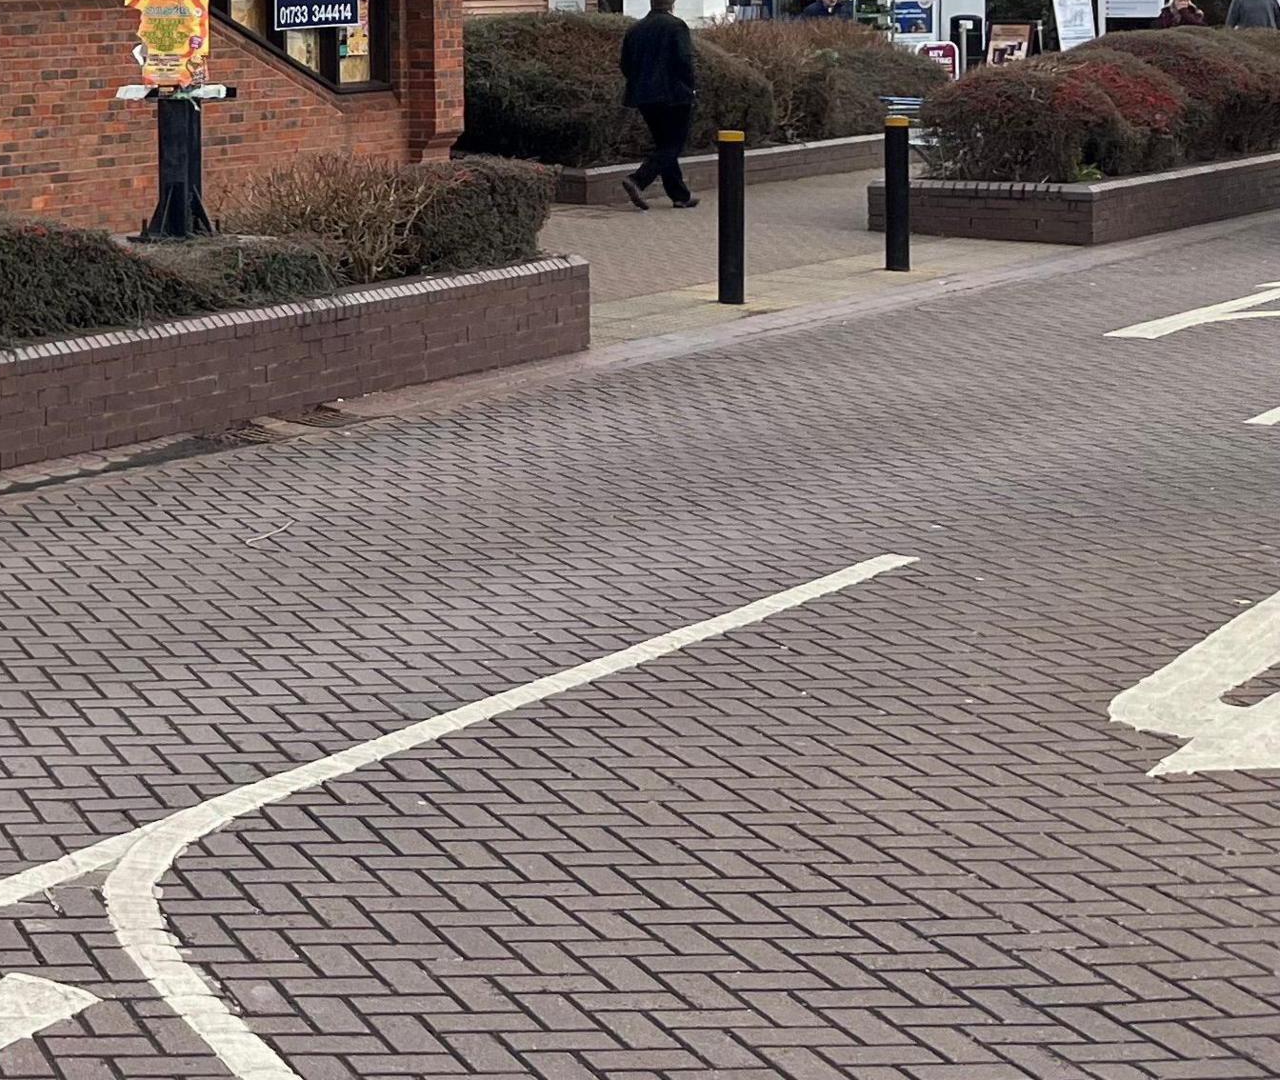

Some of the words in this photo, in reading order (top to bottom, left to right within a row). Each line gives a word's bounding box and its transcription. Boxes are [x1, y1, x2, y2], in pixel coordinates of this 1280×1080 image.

[279, 4, 308, 25] 01733
[312, 3, 352, 23] 344414
[928, 49, 944, 58] KEY
